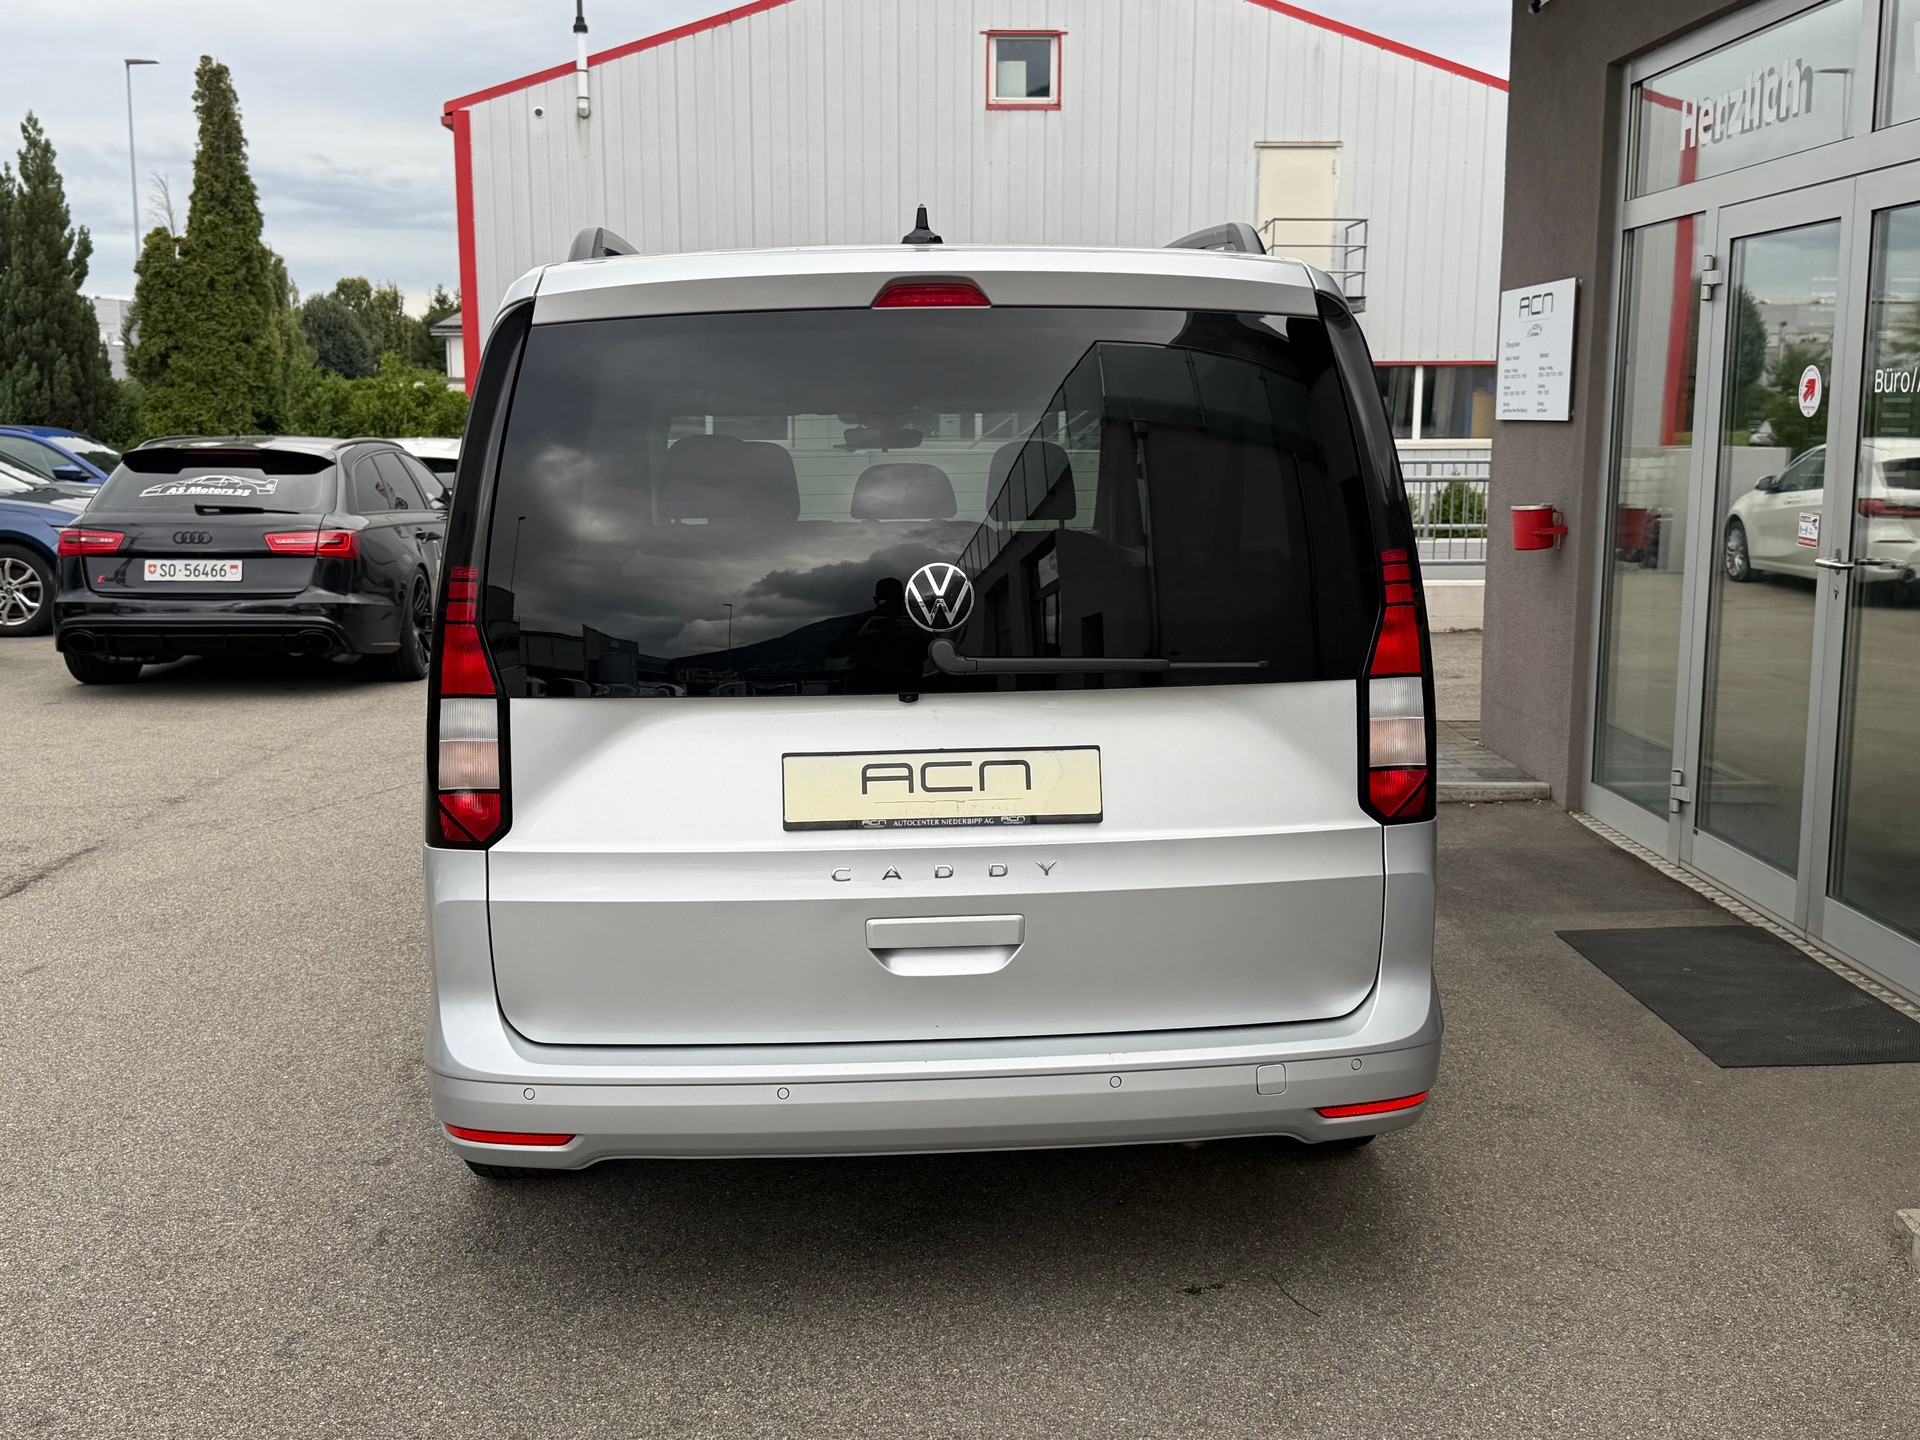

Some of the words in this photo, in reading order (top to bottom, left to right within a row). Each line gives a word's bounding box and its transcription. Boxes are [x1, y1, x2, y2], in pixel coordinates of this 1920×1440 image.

[1680, 58, 1801, 152] Herzlich
[1874, 366, 1920, 393] Büro/
[905, 562, 975, 632] VW
[893, 819, 940, 827] AUTOCENTER
[941, 817, 983, 826] NIEDERBIPP
[984, 817, 995, 825] AG
[830, 860, 1058, 882] CADDY
